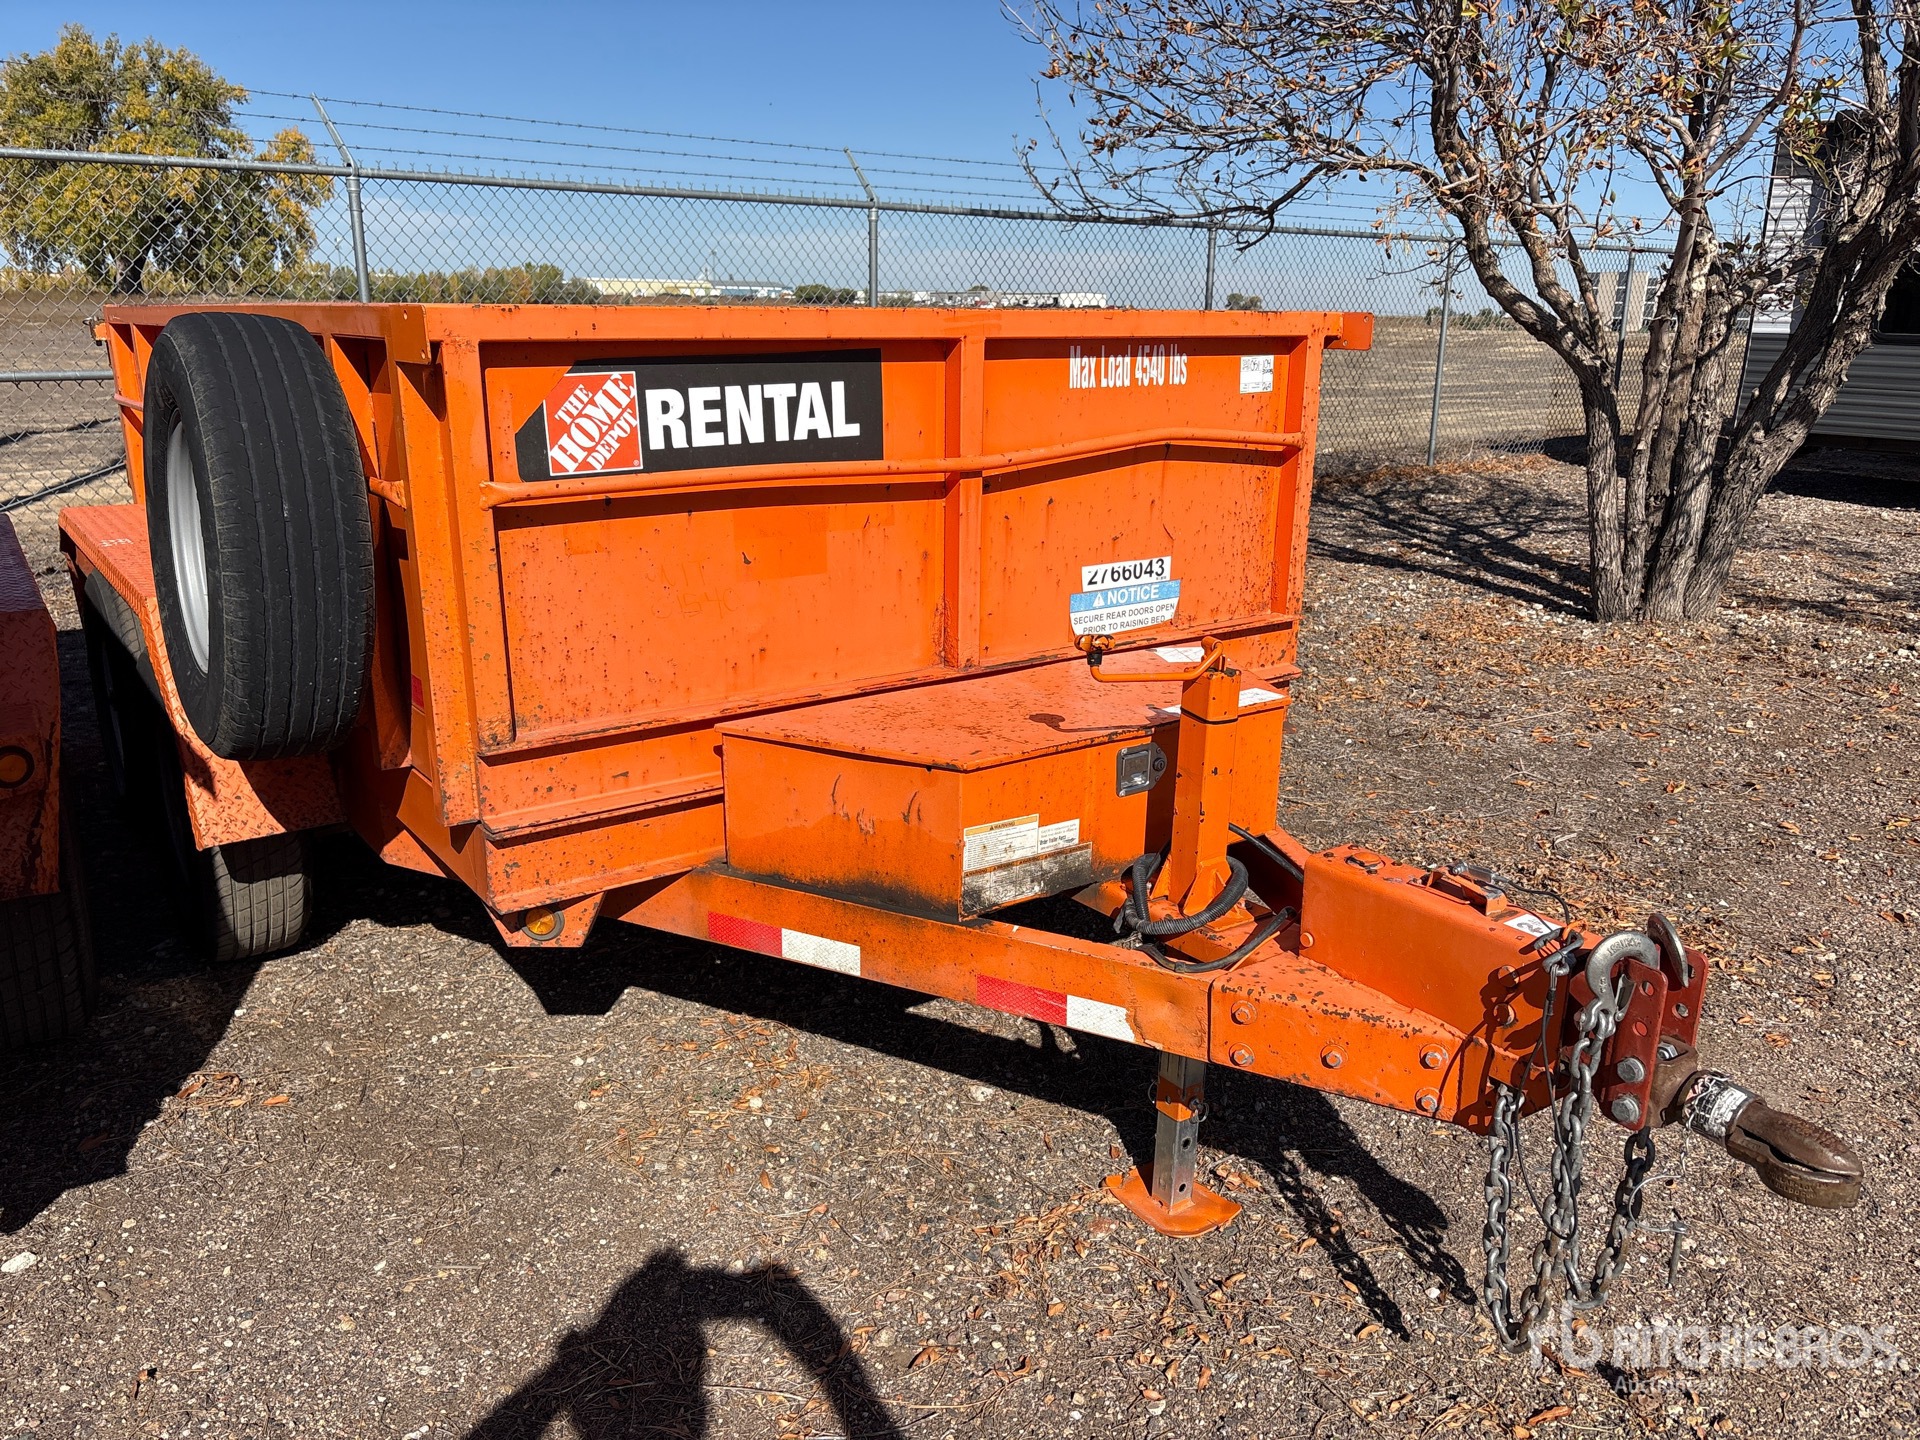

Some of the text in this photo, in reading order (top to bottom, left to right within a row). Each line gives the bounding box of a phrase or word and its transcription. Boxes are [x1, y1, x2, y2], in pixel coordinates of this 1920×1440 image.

[1069, 343, 1188, 389] Max Load 4540 lbs
[554, 383, 593, 426] THE
[645, 380, 861, 451] RENTAL
[549, 372, 637, 473] HOME
[586, 407, 639, 471] DEPOT
[1087, 558, 1165, 586] 2766043
[1107, 584, 1160, 605] NOTICE
[1073, 603, 1175, 626] SECURE REAR DOORS OPEN
[1083, 615, 1166, 634] PRIOR TO RAISING BED
[994, 821, 1016, 830] WARNING
